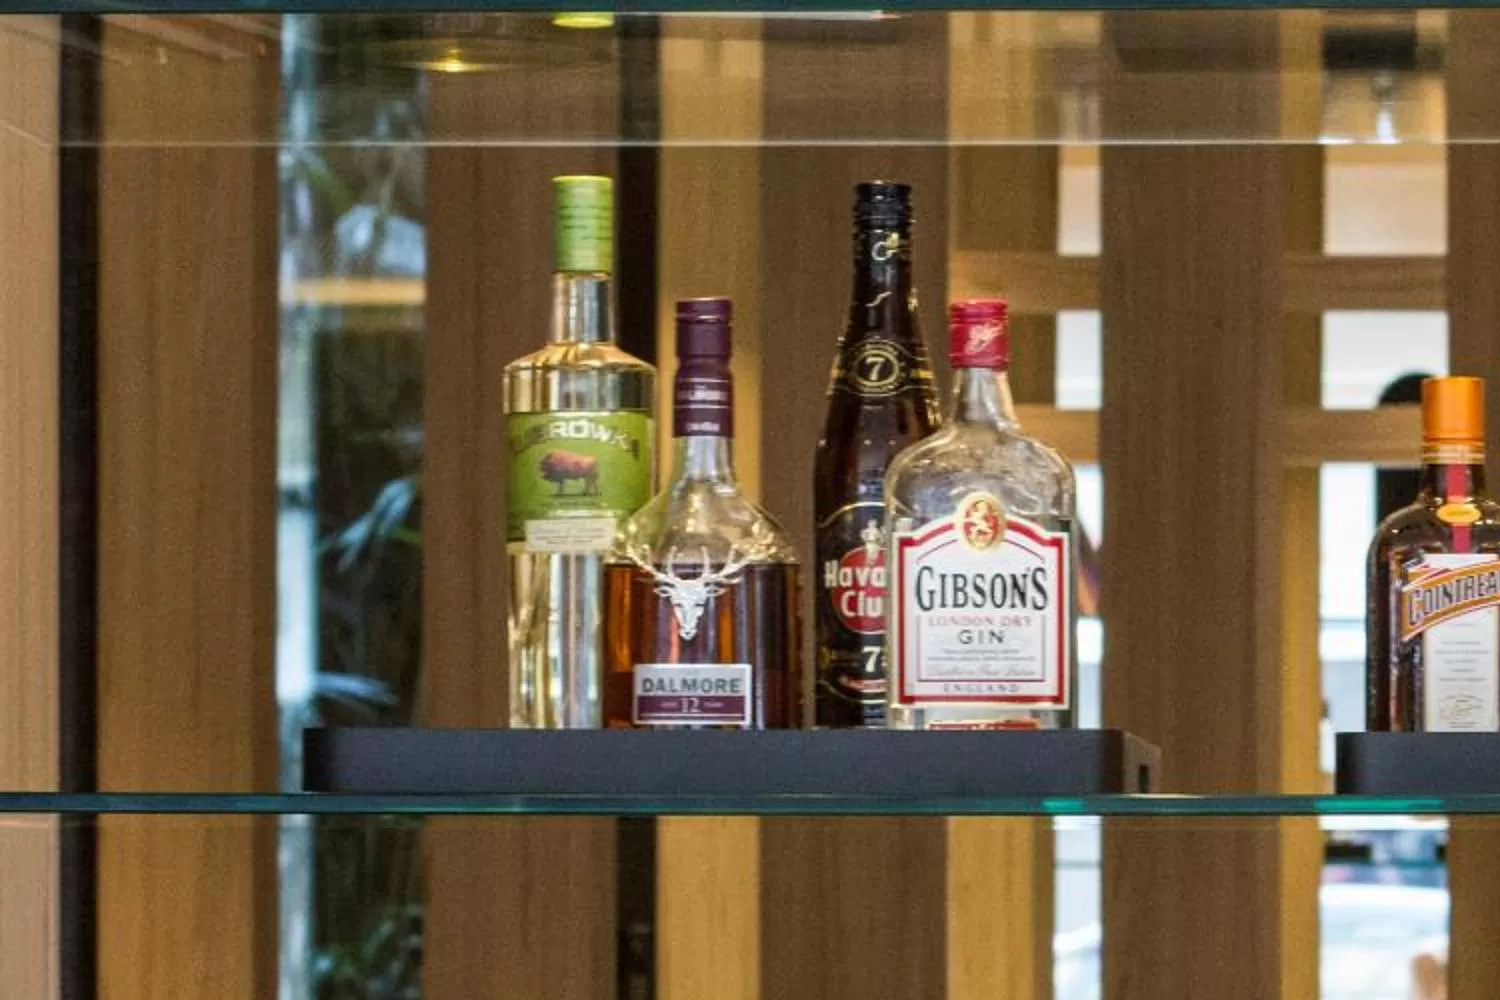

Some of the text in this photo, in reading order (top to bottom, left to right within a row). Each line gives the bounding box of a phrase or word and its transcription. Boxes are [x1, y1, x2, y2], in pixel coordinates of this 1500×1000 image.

[865, 357, 886, 381] 7
[824, 559, 887, 588] Hava
[915, 565, 1048, 612] GIBSON'S
[840, 590, 884, 618] Clu
[928, 615, 1032, 627] LONDON DRY
[957, 629, 1005, 645] GIN
[862, 645, 882, 673] 7
[642, 677, 743, 693] DALMORE
[681, 697, 701, 713] 12
